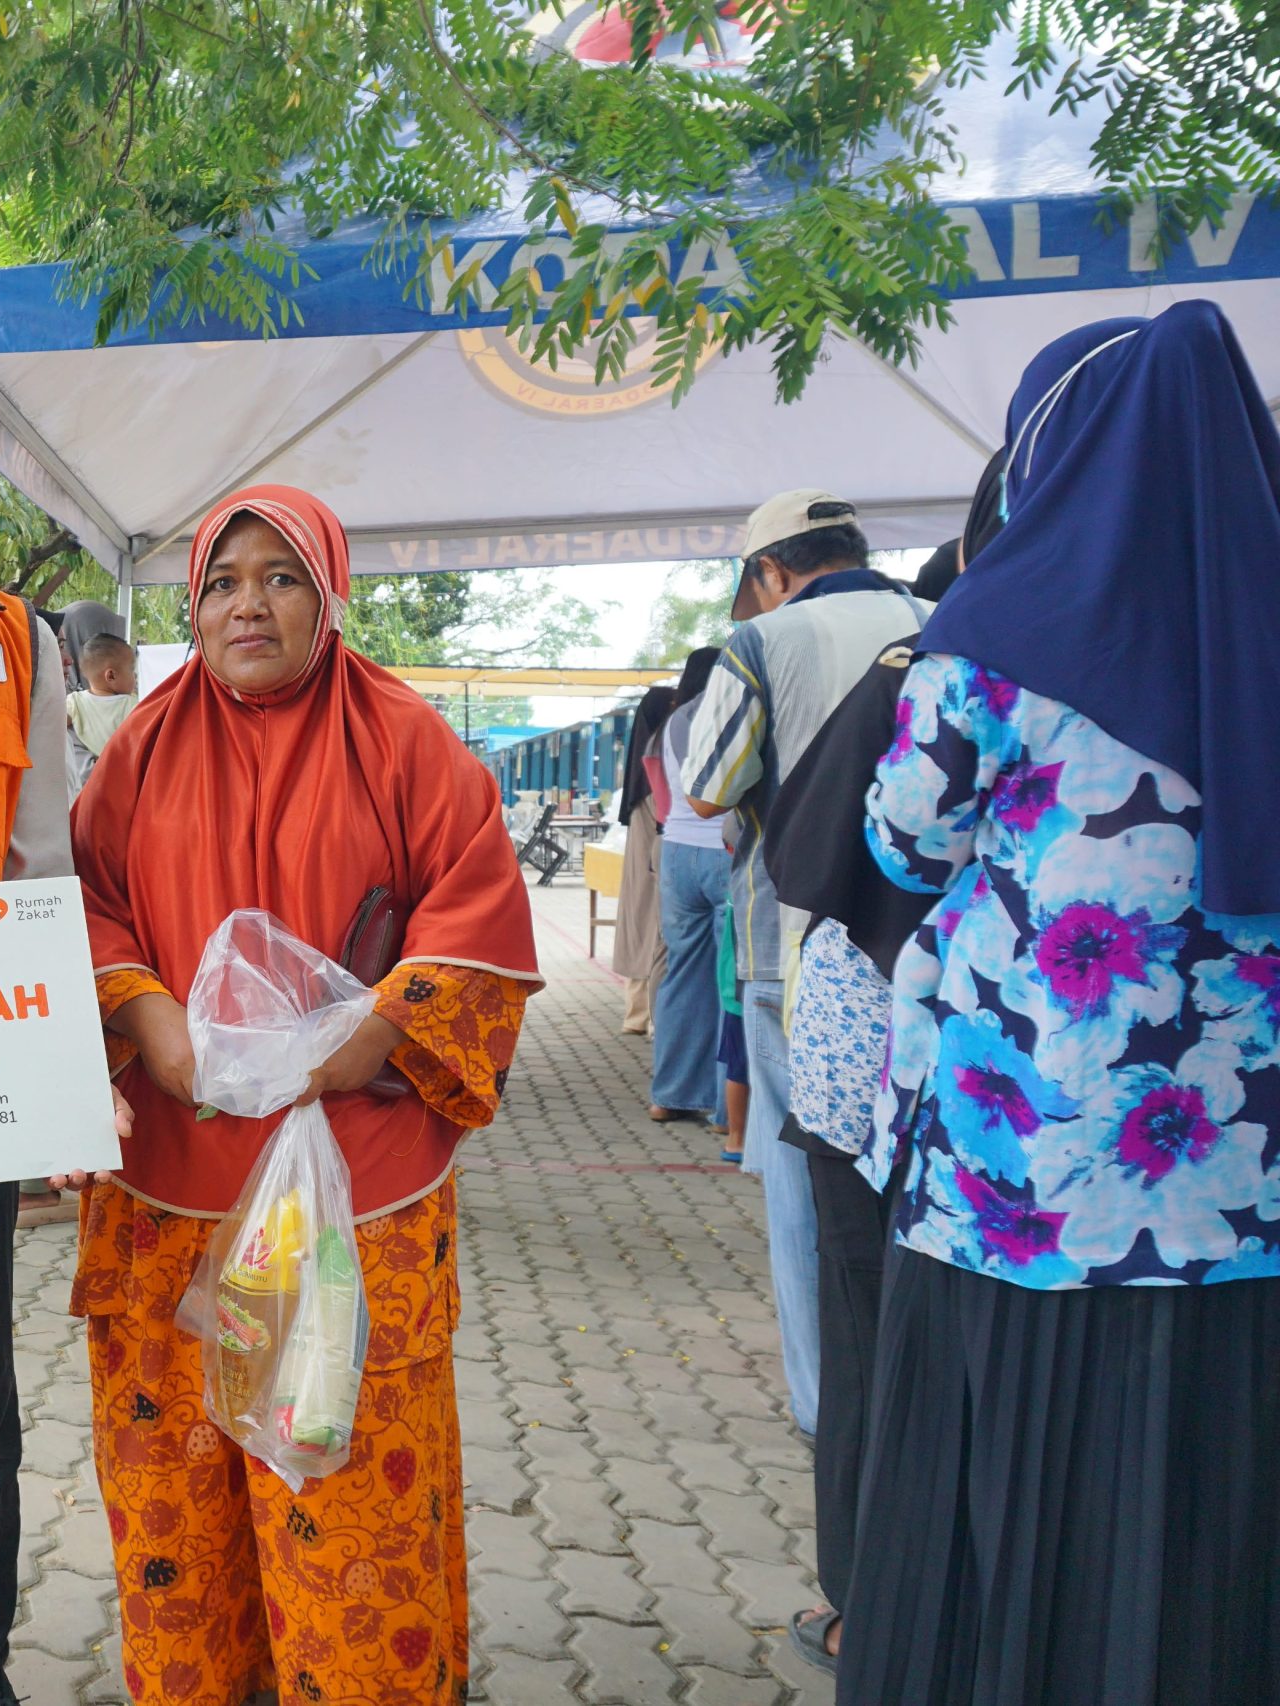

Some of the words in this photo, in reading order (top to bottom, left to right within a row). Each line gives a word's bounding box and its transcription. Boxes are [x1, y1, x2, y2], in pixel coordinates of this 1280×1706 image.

[430, 202, 1080, 315] KODAAL
[1128, 191, 1255, 272] IV
[15, 895, 62, 908] Rumah
[17, 908, 56, 921] Zakat
